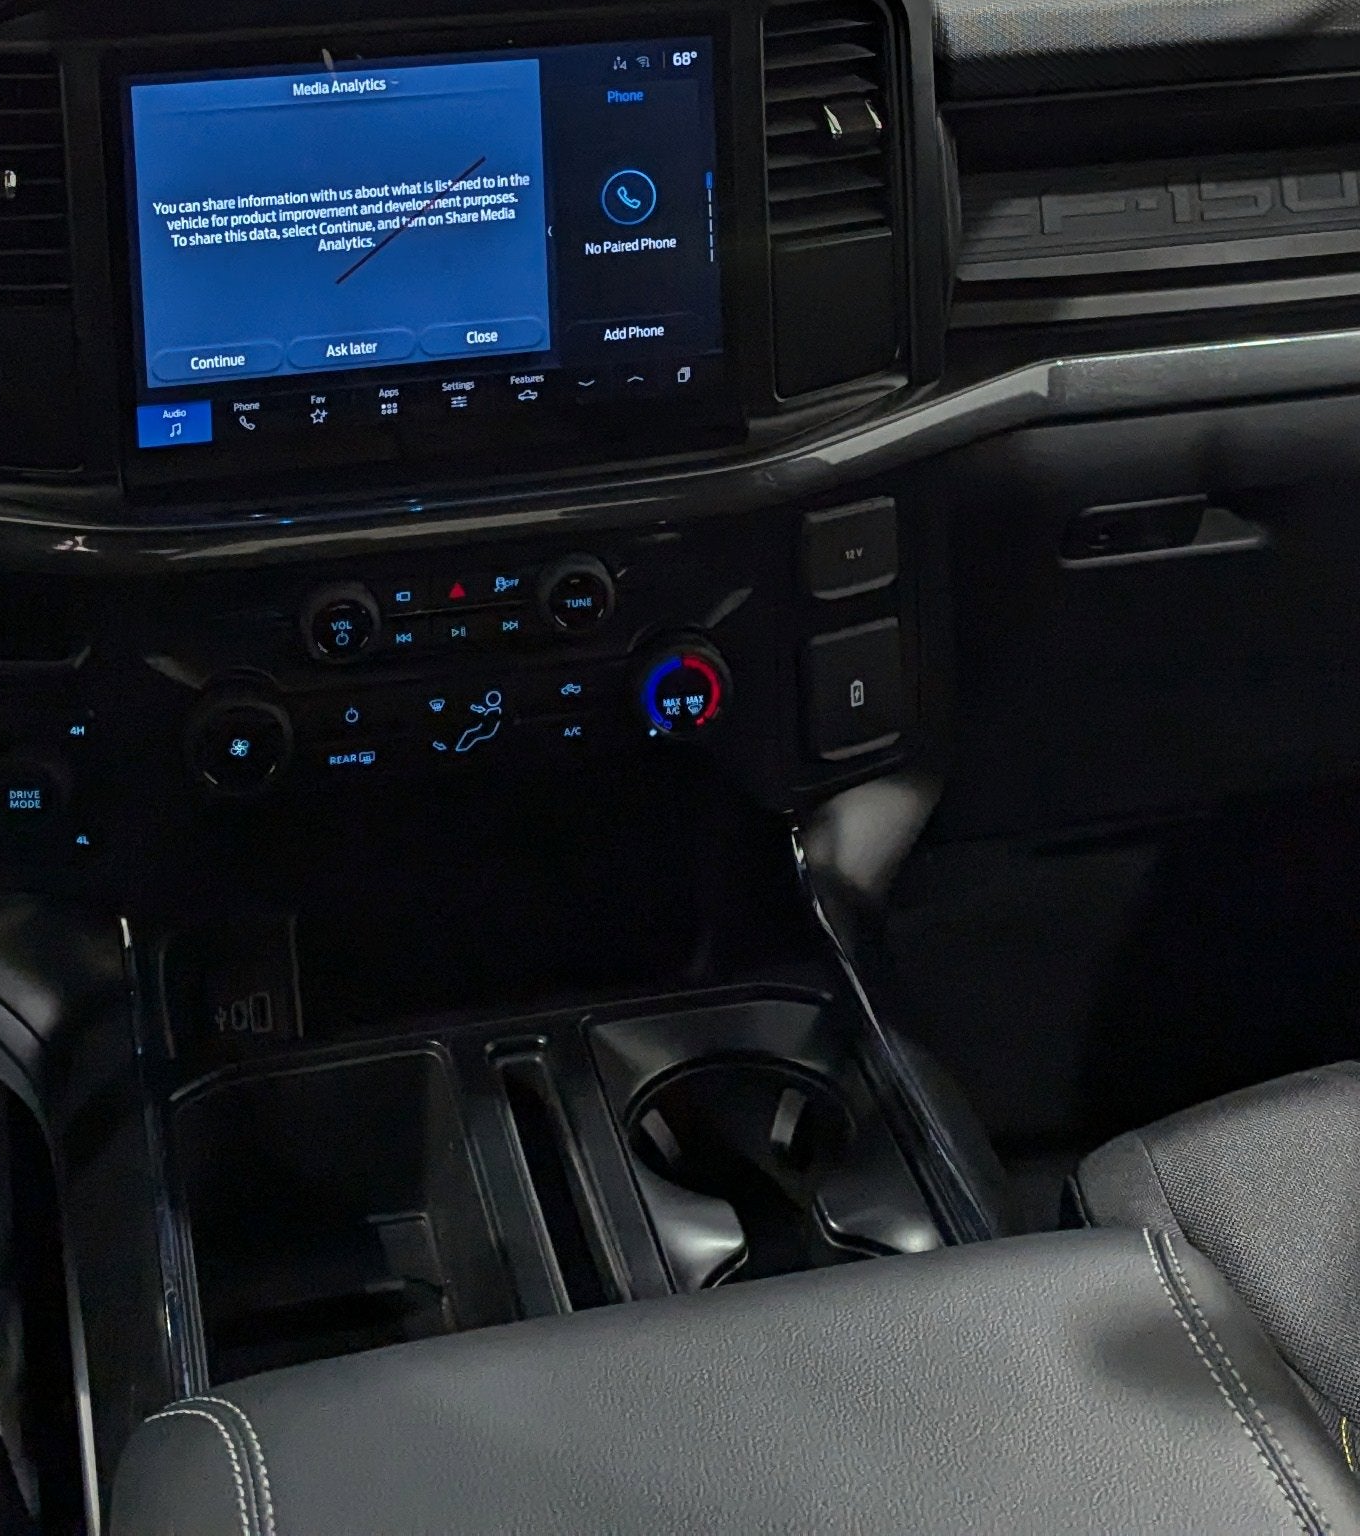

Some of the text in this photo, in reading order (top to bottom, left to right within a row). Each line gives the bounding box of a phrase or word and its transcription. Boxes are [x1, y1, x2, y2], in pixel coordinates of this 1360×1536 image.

[292, 78, 387, 96] Media Analytics
[607, 90, 644, 103] Phone
[152, 202, 177, 215] You
[178, 201, 200, 213] can
[202, 197, 236, 211] share
[237, 192, 308, 208] information
[310, 188, 337, 203] with
[339, 188, 353, 200] us
[354, 184, 389, 199] about
[391, 182, 422, 196] what
[423, 180, 433, 194] is
[483, 175, 496, 189] to
[497, 174, 508, 187] in
[510, 173, 530, 186] the
[167, 214, 209, 231] vehicle
[211, 213, 229, 227] for
[231, 210, 276, 227] product
[279, 204, 358, 222] improvement
[360, 200, 382, 214] and
[463, 192, 518, 208] purposes.
[170, 234, 187, 247] To
[189, 232, 222, 246] share
[224, 229, 248, 242] this
[249, 227, 280, 240] data,
[282, 223, 317, 237] select
[319, 219, 375, 235] Continue,
[377, 216, 399, 230] and
[428, 213, 443, 226] on
[445, 210, 479, 224] Share
[480, 207, 516, 221] Media
[318, 236, 375, 252] Analytics.
[584, 237, 677, 256] No Paired Phone
[466, 331, 498, 344] Close
[603, 325, 665, 341] Add Phone
[326, 341, 378, 357] Ask later
[190, 354, 246, 370] Continue
[510, 374, 545, 385] Features
[441, 380, 475, 392] Settings
[378, 388, 400, 398] Apps
[310, 395, 326, 405] Fav
[233, 401, 260, 412] Phone
[162, 408, 187, 419] Audio
[565, 597, 593, 609] TUNE
[331, 620, 353, 631] VOL
[69, 726, 85, 736] 4H
[563, 726, 582, 737] A/C
[329, 754, 357, 765] REAR
[9, 790, 40, 799] DRIVE
[9, 800, 42, 809] MODE
[76, 835, 89, 845] 4L
